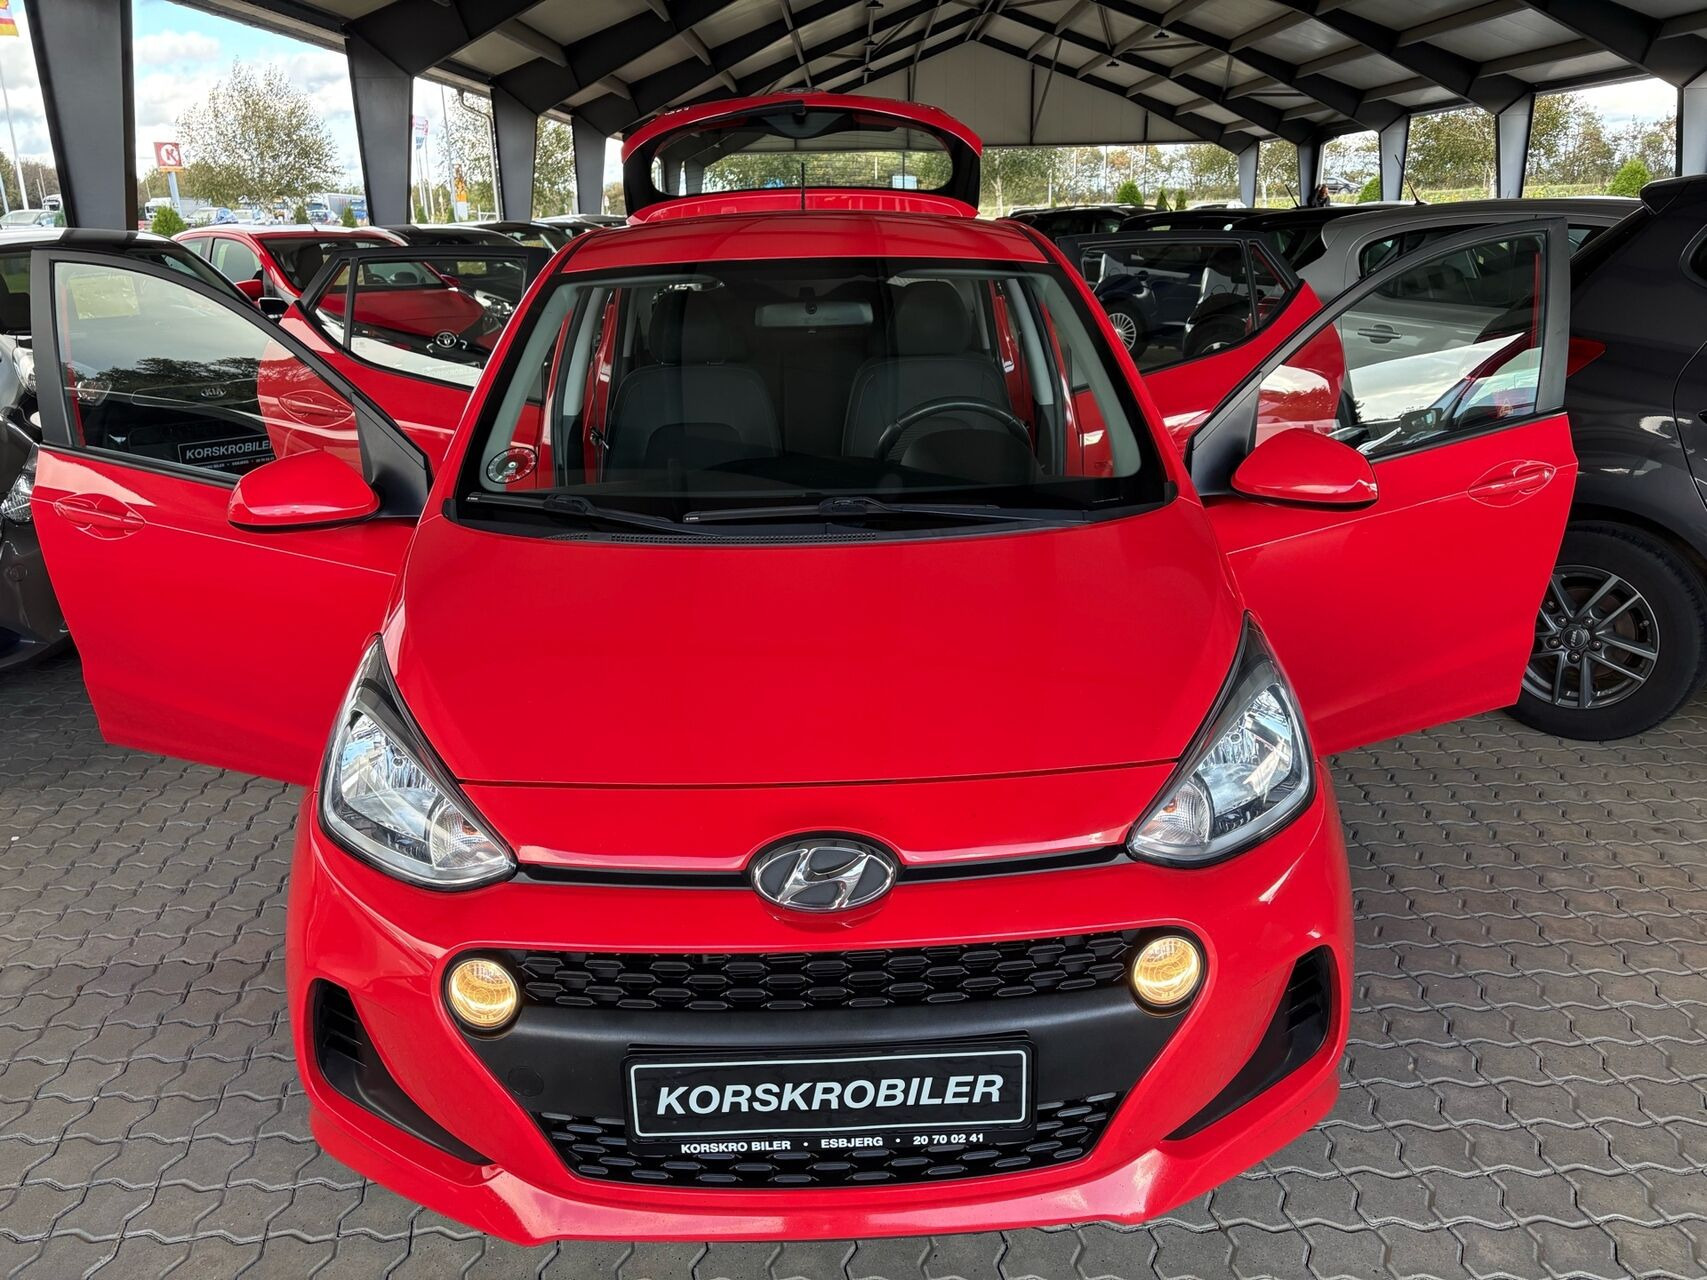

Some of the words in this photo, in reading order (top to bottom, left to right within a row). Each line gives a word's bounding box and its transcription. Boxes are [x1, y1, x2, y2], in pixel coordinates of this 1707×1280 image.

[656, 1074, 1004, 1116] KORSKROBILER
[681, 1142, 748, 1154] KORSKRO
[751, 1140, 791, 1151] BILER
[820, 1137, 884, 1148] ESBJERG
[913, 1136, 929, 1145] 20
[932, 1135, 948, 1144] 70
[950, 1134, 967, 1143] 02
[969, 1133, 984, 1142] 41
